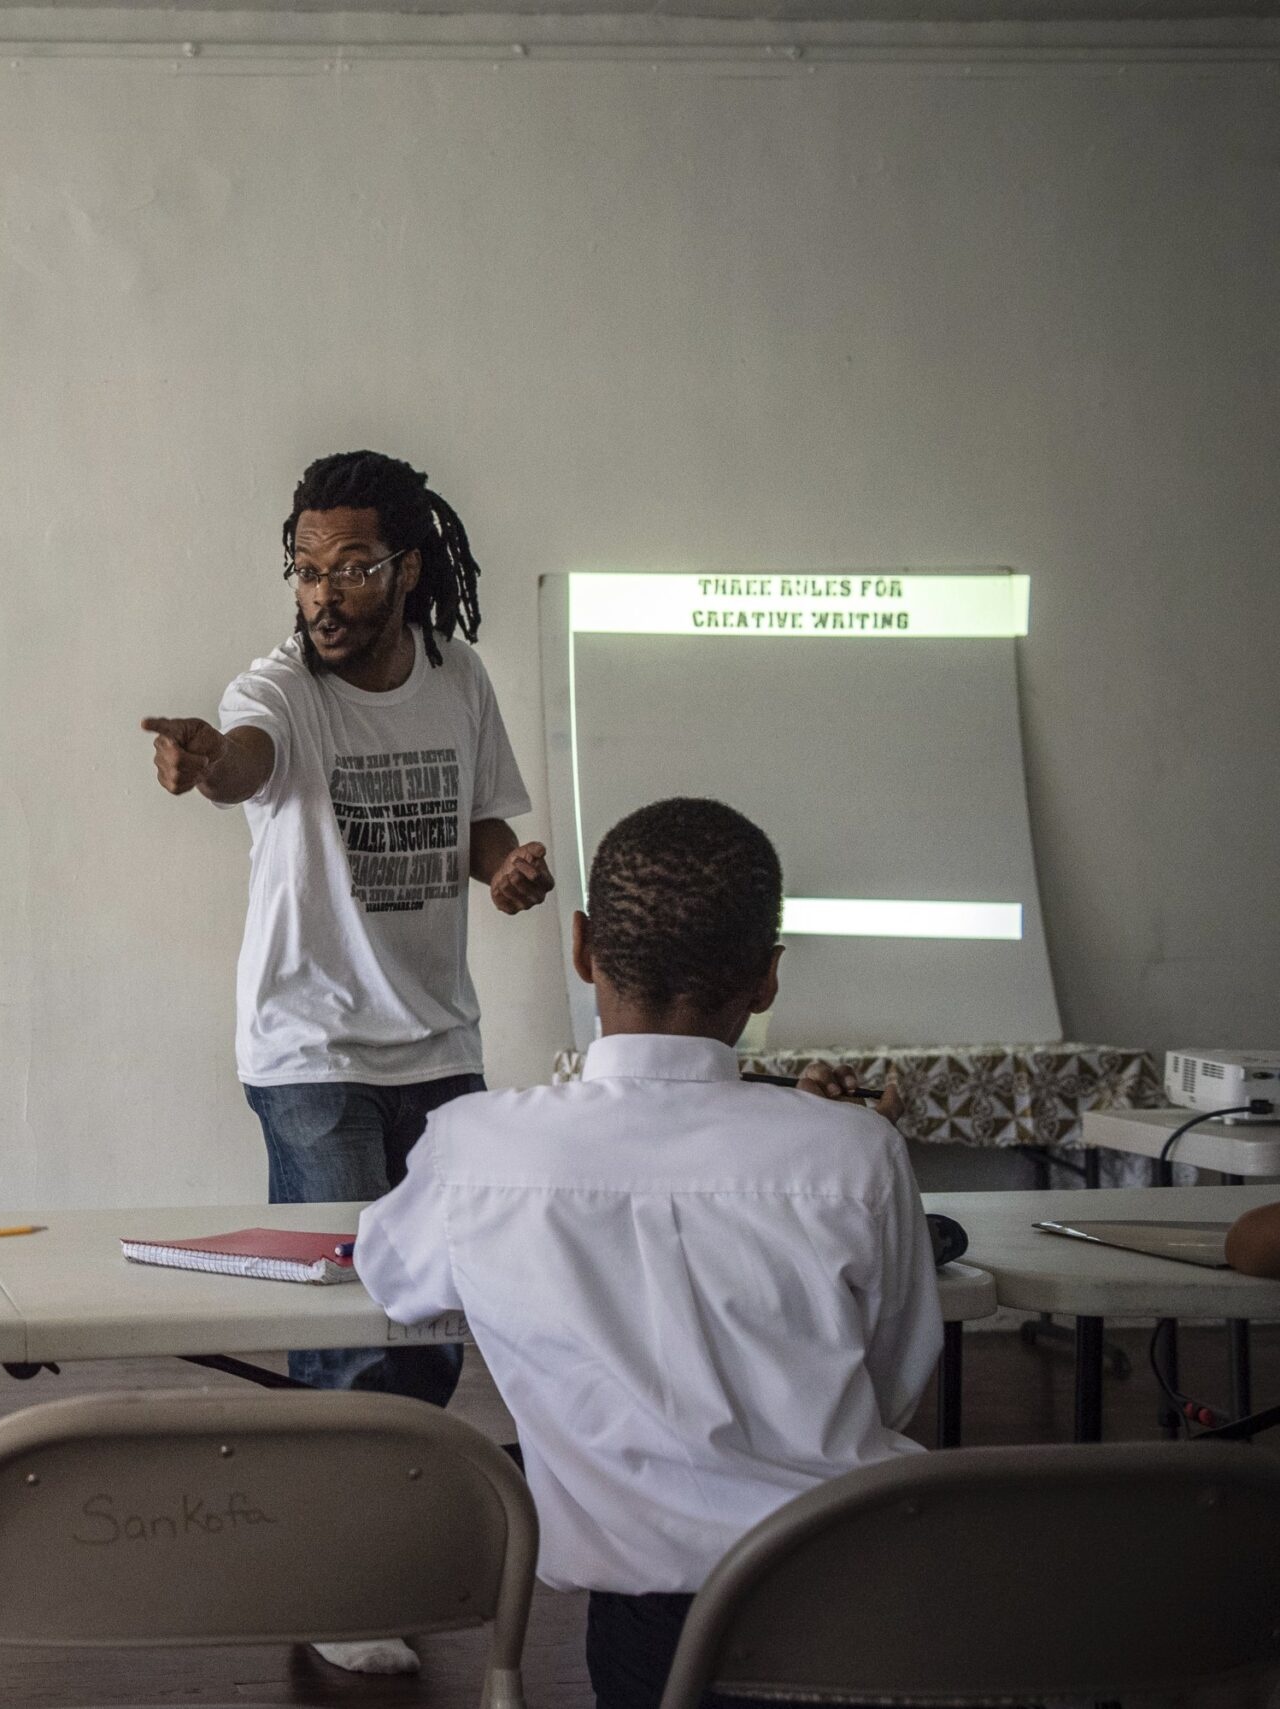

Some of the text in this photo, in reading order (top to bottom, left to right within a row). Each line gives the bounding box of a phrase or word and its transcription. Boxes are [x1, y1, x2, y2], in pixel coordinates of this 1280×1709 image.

[698, 579, 903, 598] THREE RULES FOR
[692, 610, 909, 630] CREATIVE WRITING
